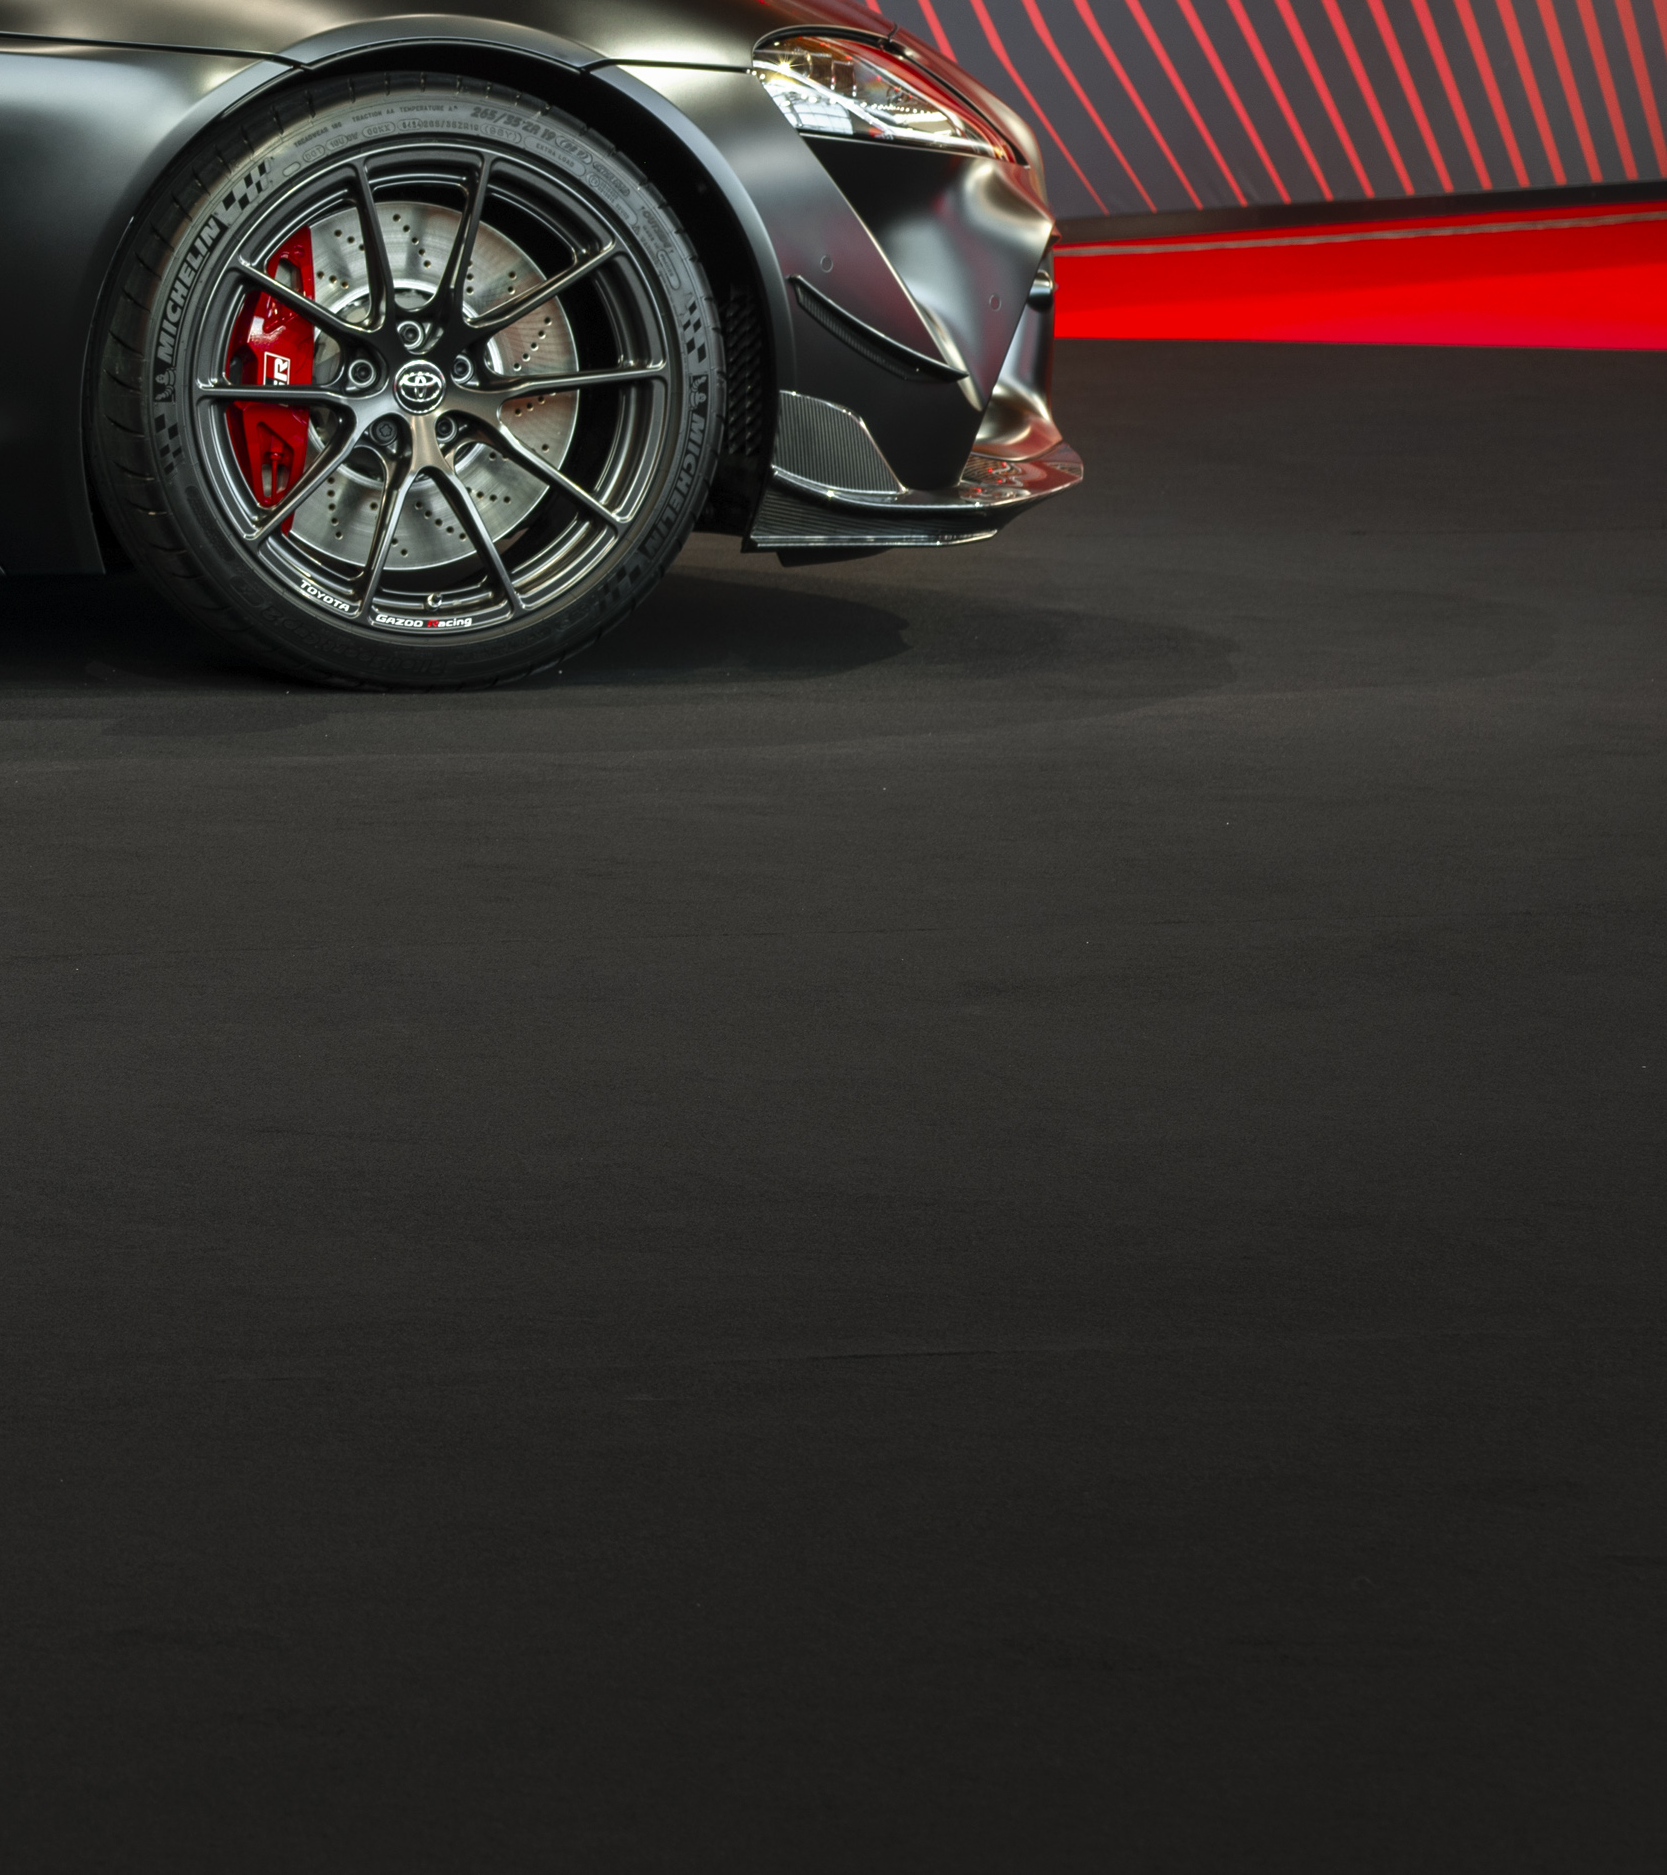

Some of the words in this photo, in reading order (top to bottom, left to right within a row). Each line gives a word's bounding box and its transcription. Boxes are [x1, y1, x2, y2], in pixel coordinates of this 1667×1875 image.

[351, 110, 381, 122] TRACTION
[540, 127, 557, 143] 19
[156, 216, 222, 363] MICHELIN
[643, 413, 705, 556] MICHELIN
[300, 579, 350, 612] TOYOTA
[375, 614, 423, 628] GAZOO
[427, 617, 472, 628] Racing
